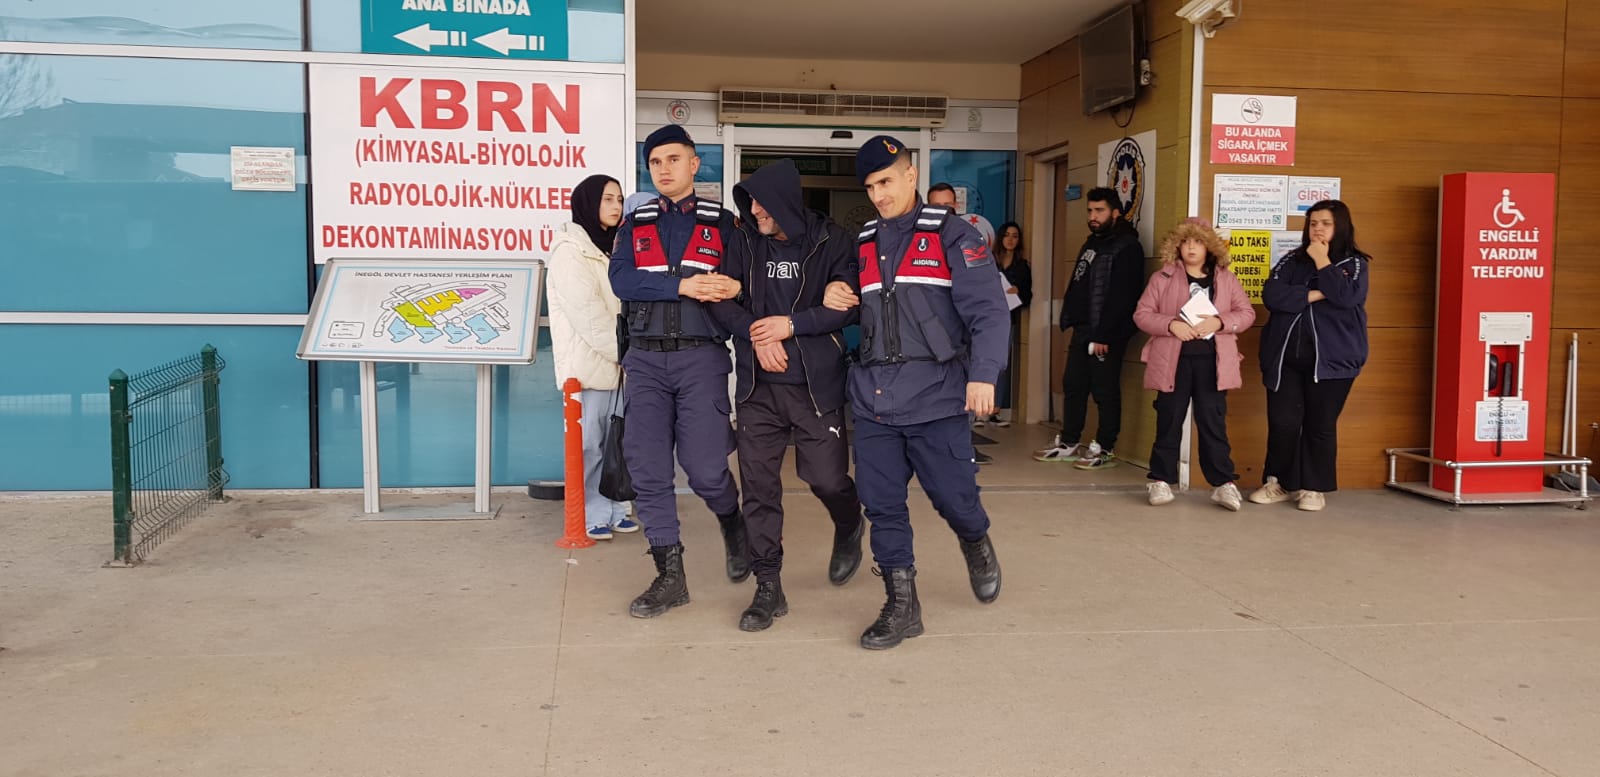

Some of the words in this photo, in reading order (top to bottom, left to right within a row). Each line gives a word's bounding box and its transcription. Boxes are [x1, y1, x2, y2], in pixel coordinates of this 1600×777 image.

[359, 76, 580, 134] KBRN
[1225, 126, 1240, 137] BU
[1241, 127, 1282, 138] ALANDA
[355, 134, 587, 168] (KİMYASAL-BİYOLOJİK
[1217, 138, 1255, 150] SİGARA
[1256, 139, 1289, 152] İÇMEK
[1228, 153, 1277, 163] YASAKTIR
[323, 222, 532, 251] DEKONTAMİNASYON
[1229, 236, 1244, 246] ALO
[1479, 227, 1540, 243] ENGELLİ
[1231, 254, 1265, 262] HASTANE
[1479, 247, 1538, 260] YARDIM
[1471, 265, 1544, 279] TELEFONU
